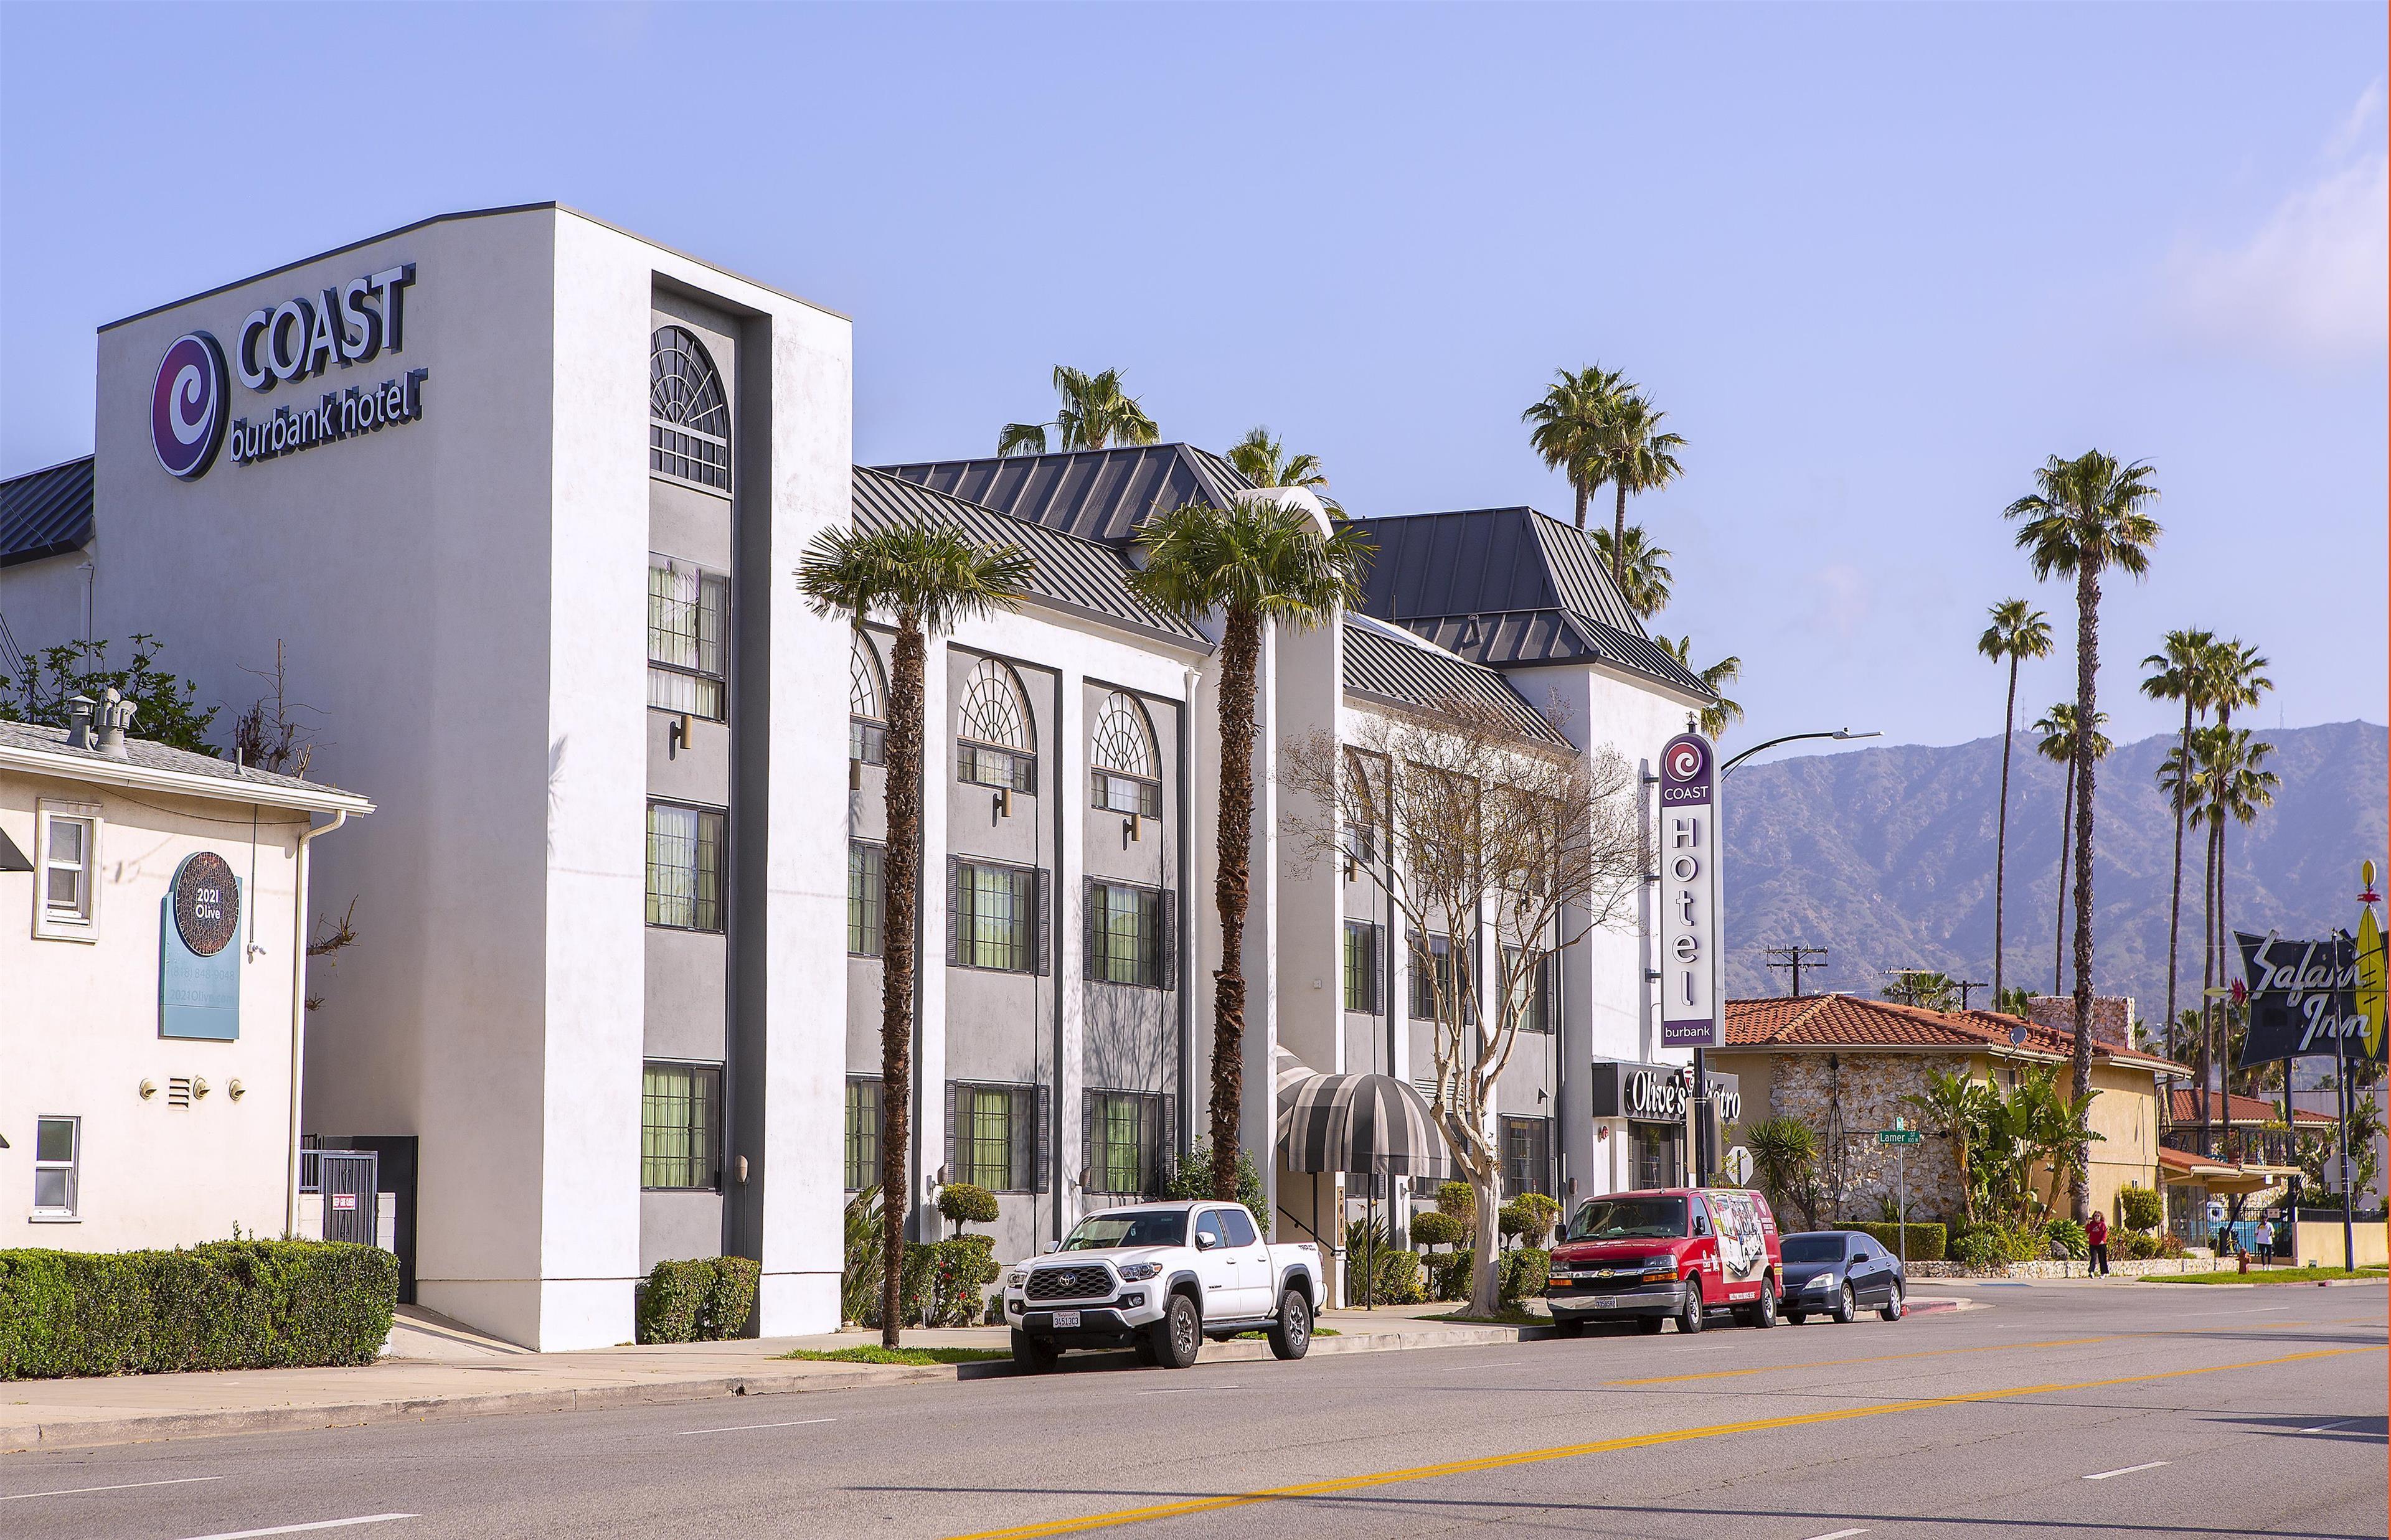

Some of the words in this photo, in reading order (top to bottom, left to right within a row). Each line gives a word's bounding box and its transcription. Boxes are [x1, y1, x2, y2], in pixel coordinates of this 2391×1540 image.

[236, 264, 413, 392] COAST
[229, 393, 336, 462] burbank
[341, 370, 423, 433] hotel
[1664, 786, 1709, 801] COAST
[195, 904, 220, 919] Olive
[197, 888, 219, 903] 2021
[1670, 817, 1699, 1006] Hotel
[2251, 929, 2367, 1007] Safari
[1665, 1025, 1710, 1038] burbank
[2298, 993, 2372, 1051] Inn
[1632, 1069, 1686, 1115] Olive's
[1880, 1132, 1905, 1142] Lamer
